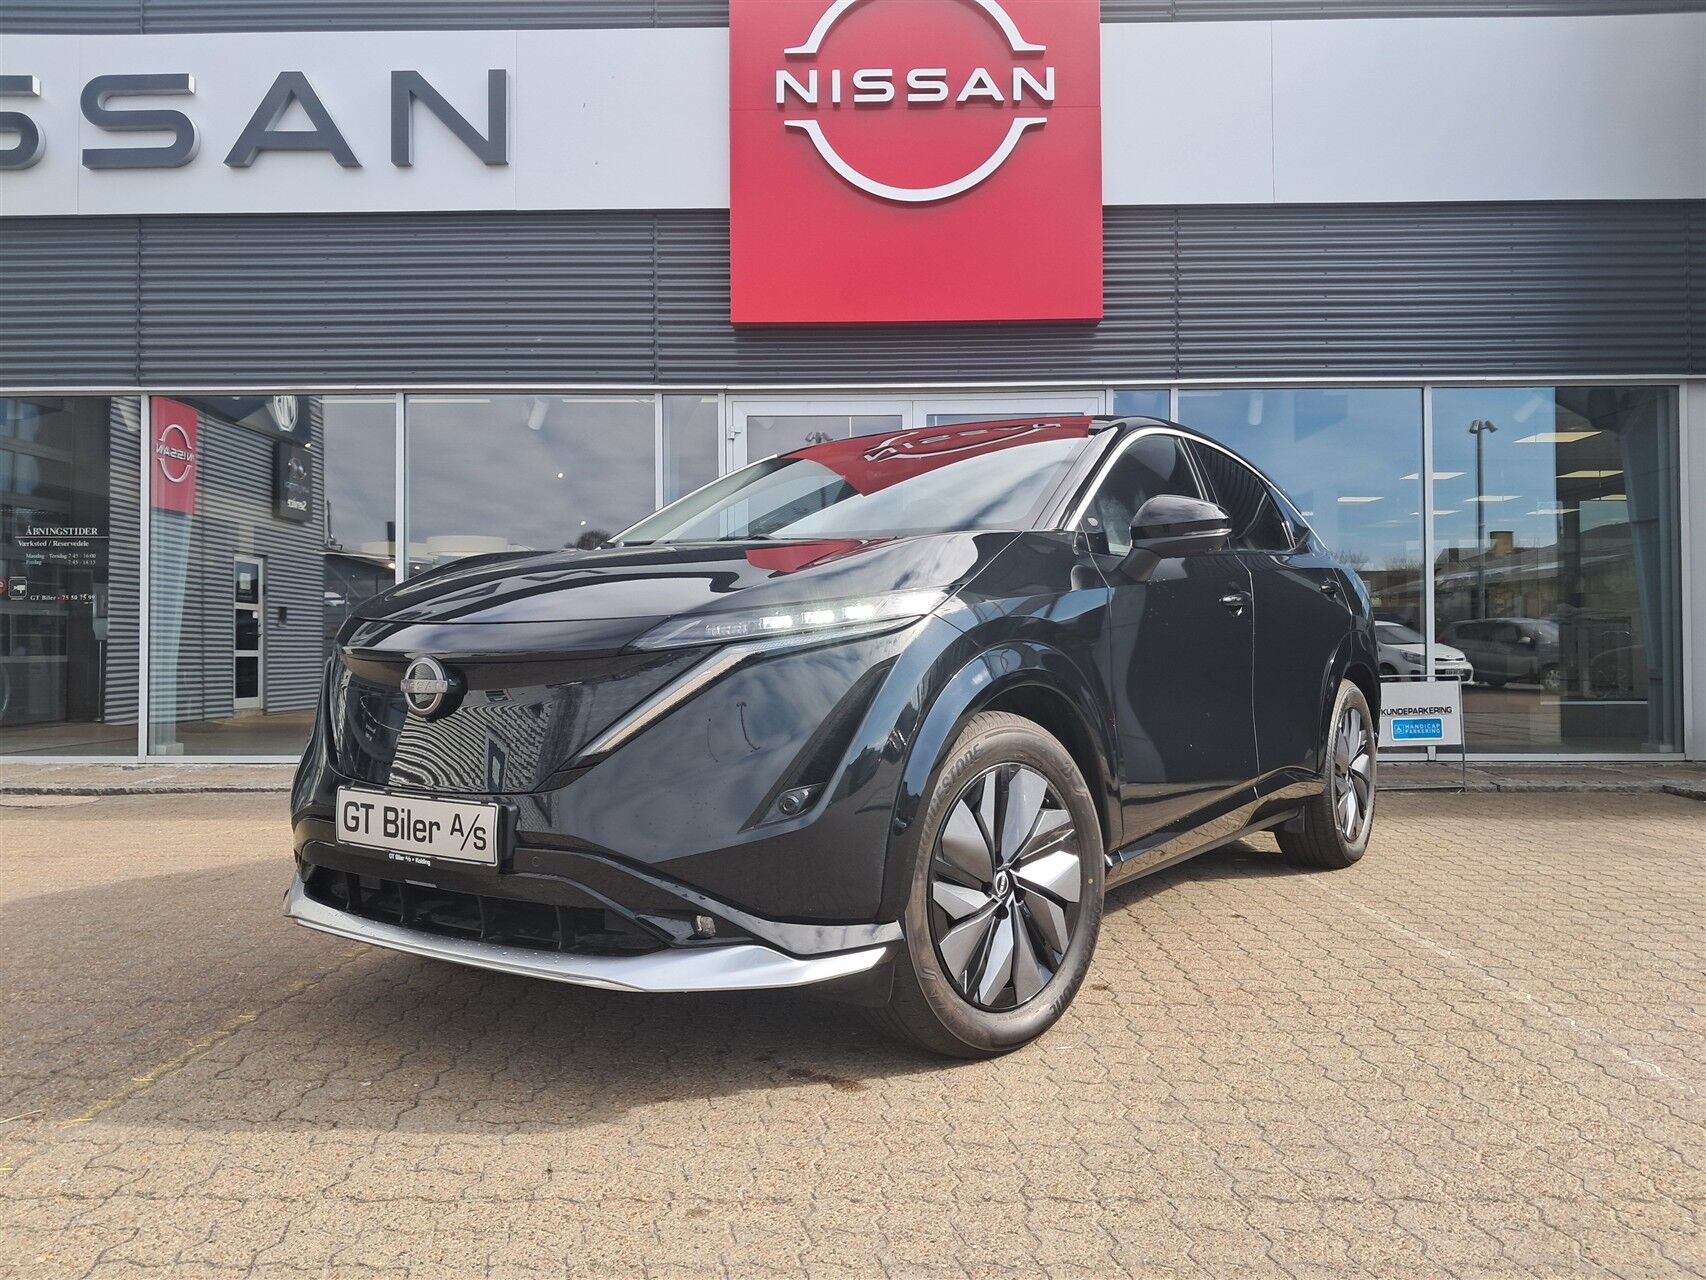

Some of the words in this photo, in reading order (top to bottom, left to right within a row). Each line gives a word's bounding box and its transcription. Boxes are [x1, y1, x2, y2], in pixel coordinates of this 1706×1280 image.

[775, 66, 1055, 103] NISSAN
[26, 525, 98, 535] ÅBNINGSTIDER
[1381, 706, 1453, 716] KUNDEPARKERING
[343, 801, 375, 834] GT
[383, 806, 441, 843] Biler
[415, 857, 431, 867] Kolding
